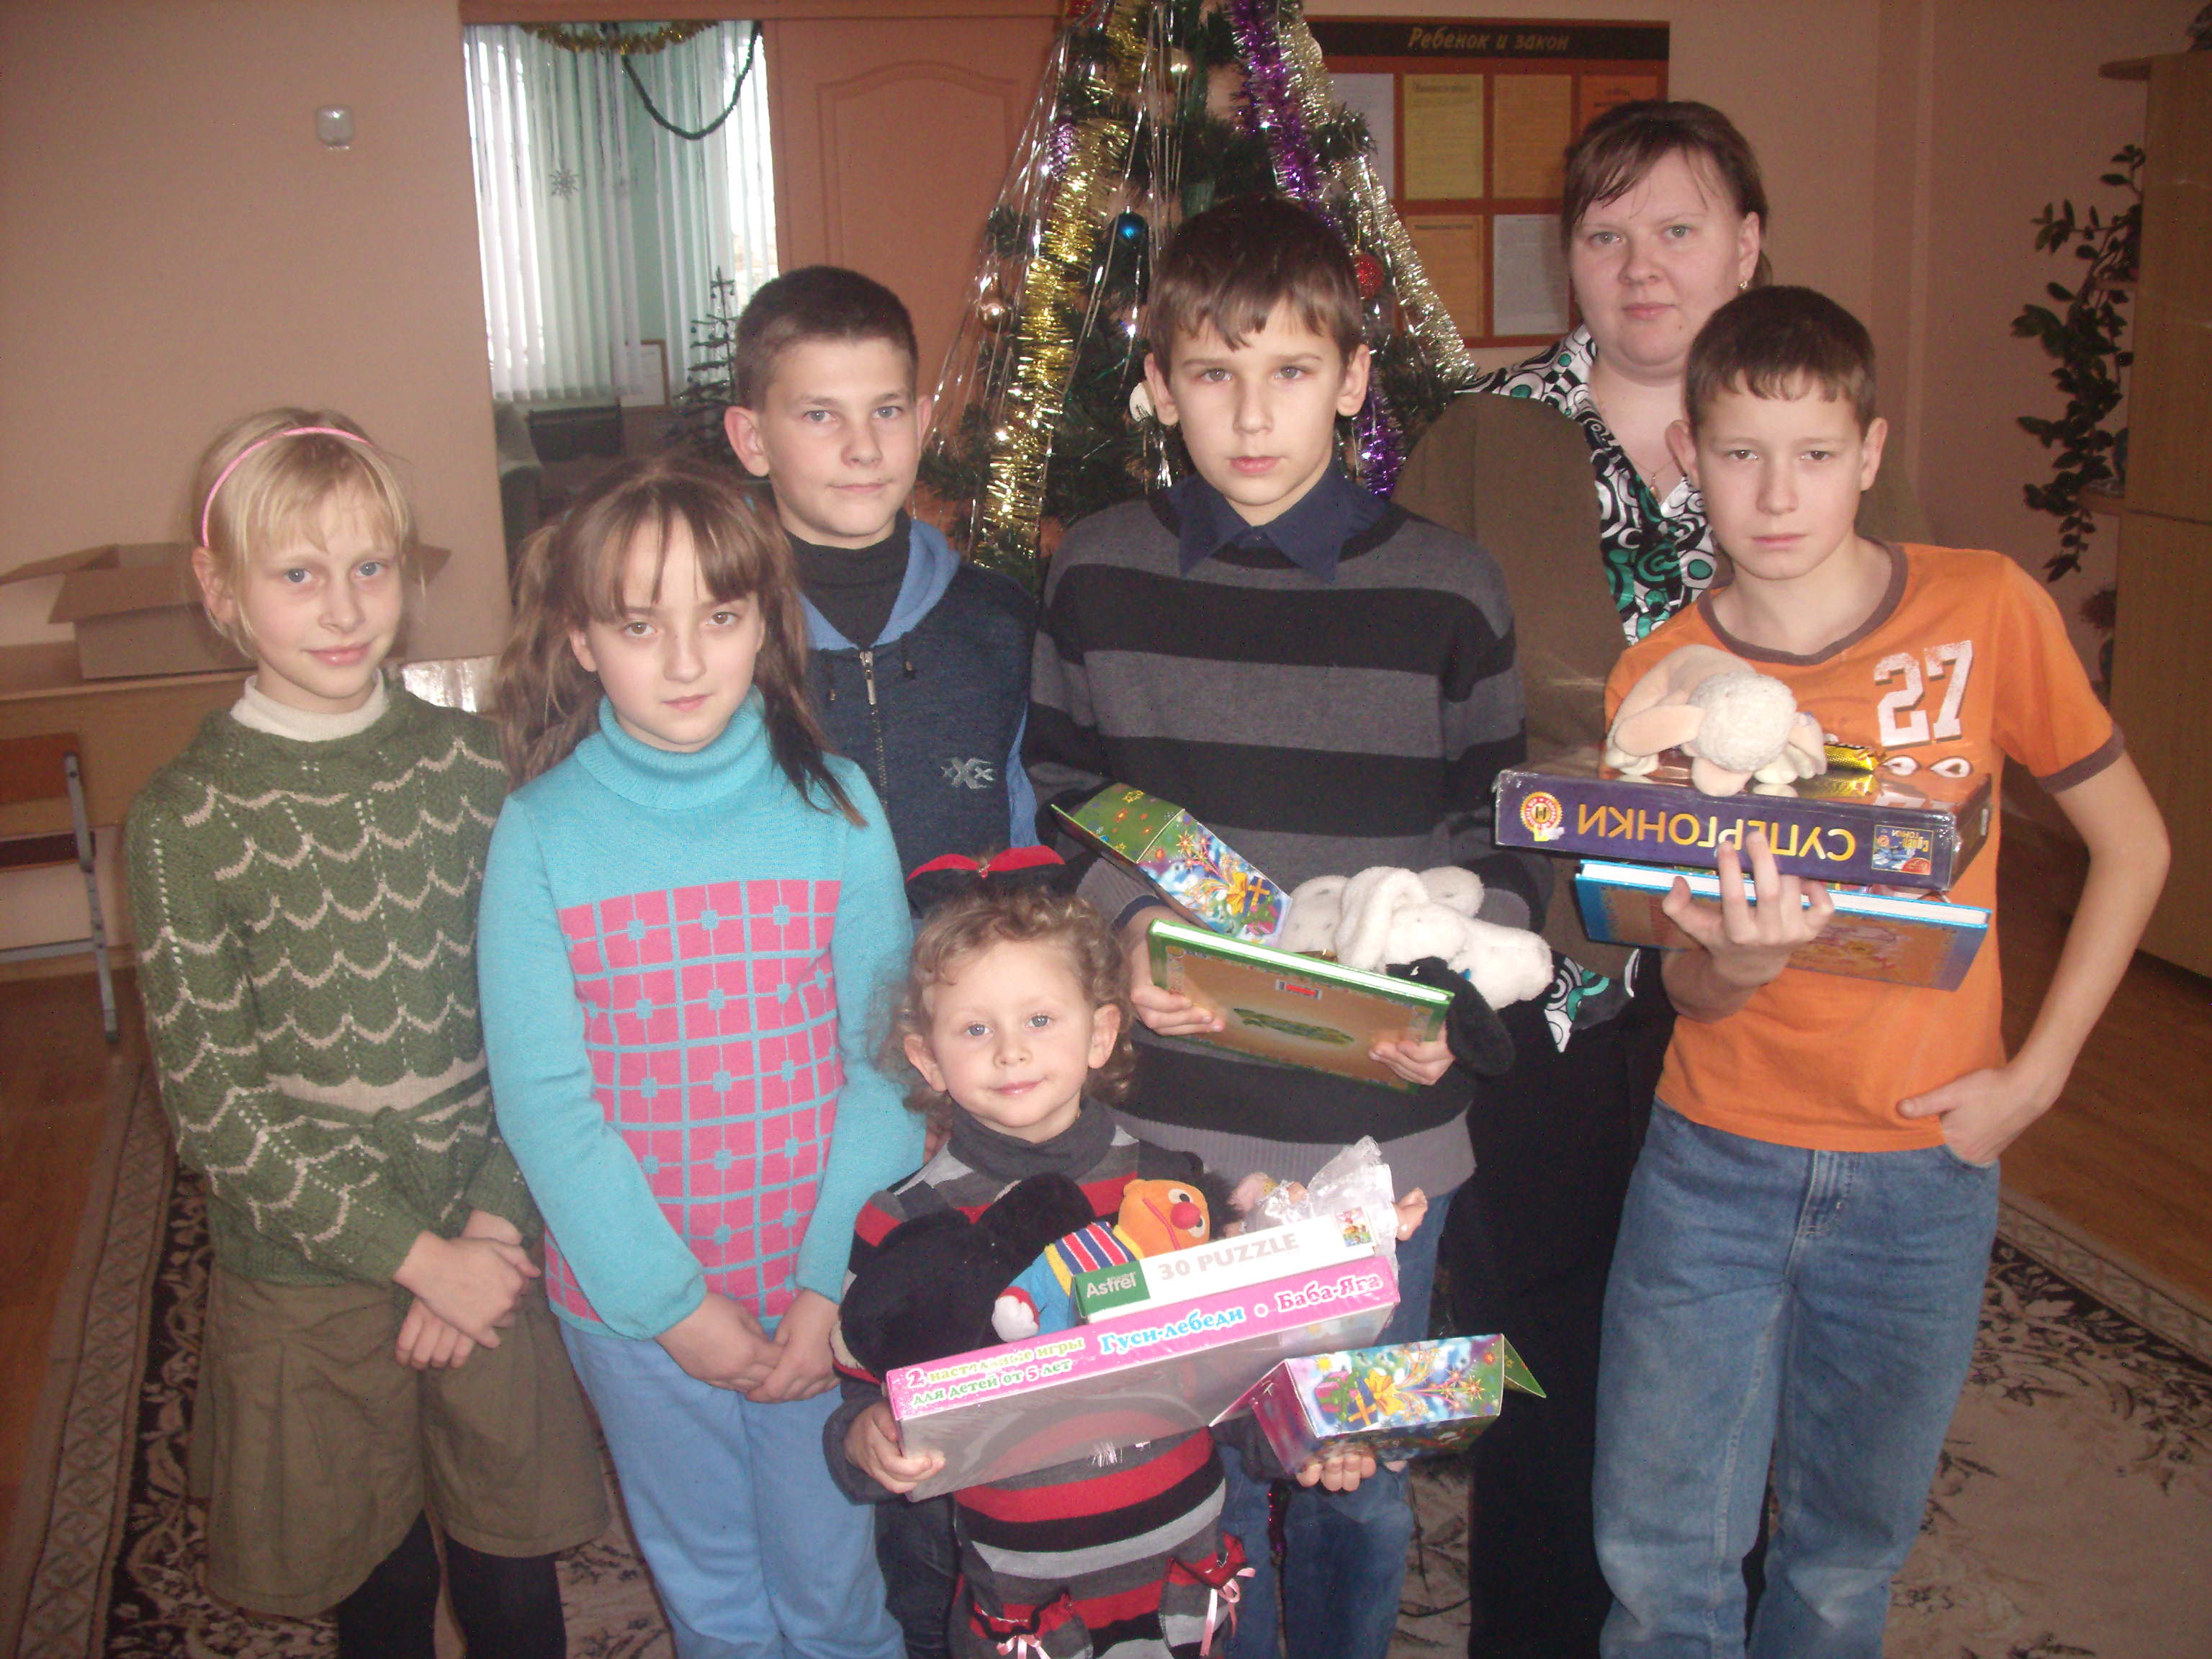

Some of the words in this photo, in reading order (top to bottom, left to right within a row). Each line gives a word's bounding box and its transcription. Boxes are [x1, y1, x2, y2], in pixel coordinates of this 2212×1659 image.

[1408, 26, 1489, 50] Ребенок
[1496, 35, 1509, 50] и
[1515, 34, 1569, 50] закон
[1874, 640, 1974, 750] 27
[1158, 1259, 1190, 1280] 30
[1197, 1233, 1299, 1272] PUZZLE
[1087, 1272, 1136, 1298] Astrel
[907, 1369, 924, 1387] 2
[1037, 1338, 1084, 1359] игры
[1101, 1307, 1244, 1354] Гуси-лебеди
[1277, 1274, 1382, 1311] Баба-Яга
[914, 1388, 944, 1406] для
[950, 1375, 998, 1398] детей
[1002, 1372, 1022, 1385] от
[1027, 1368, 1039, 1381] 5
[1043, 1360, 1071, 1376] лет
